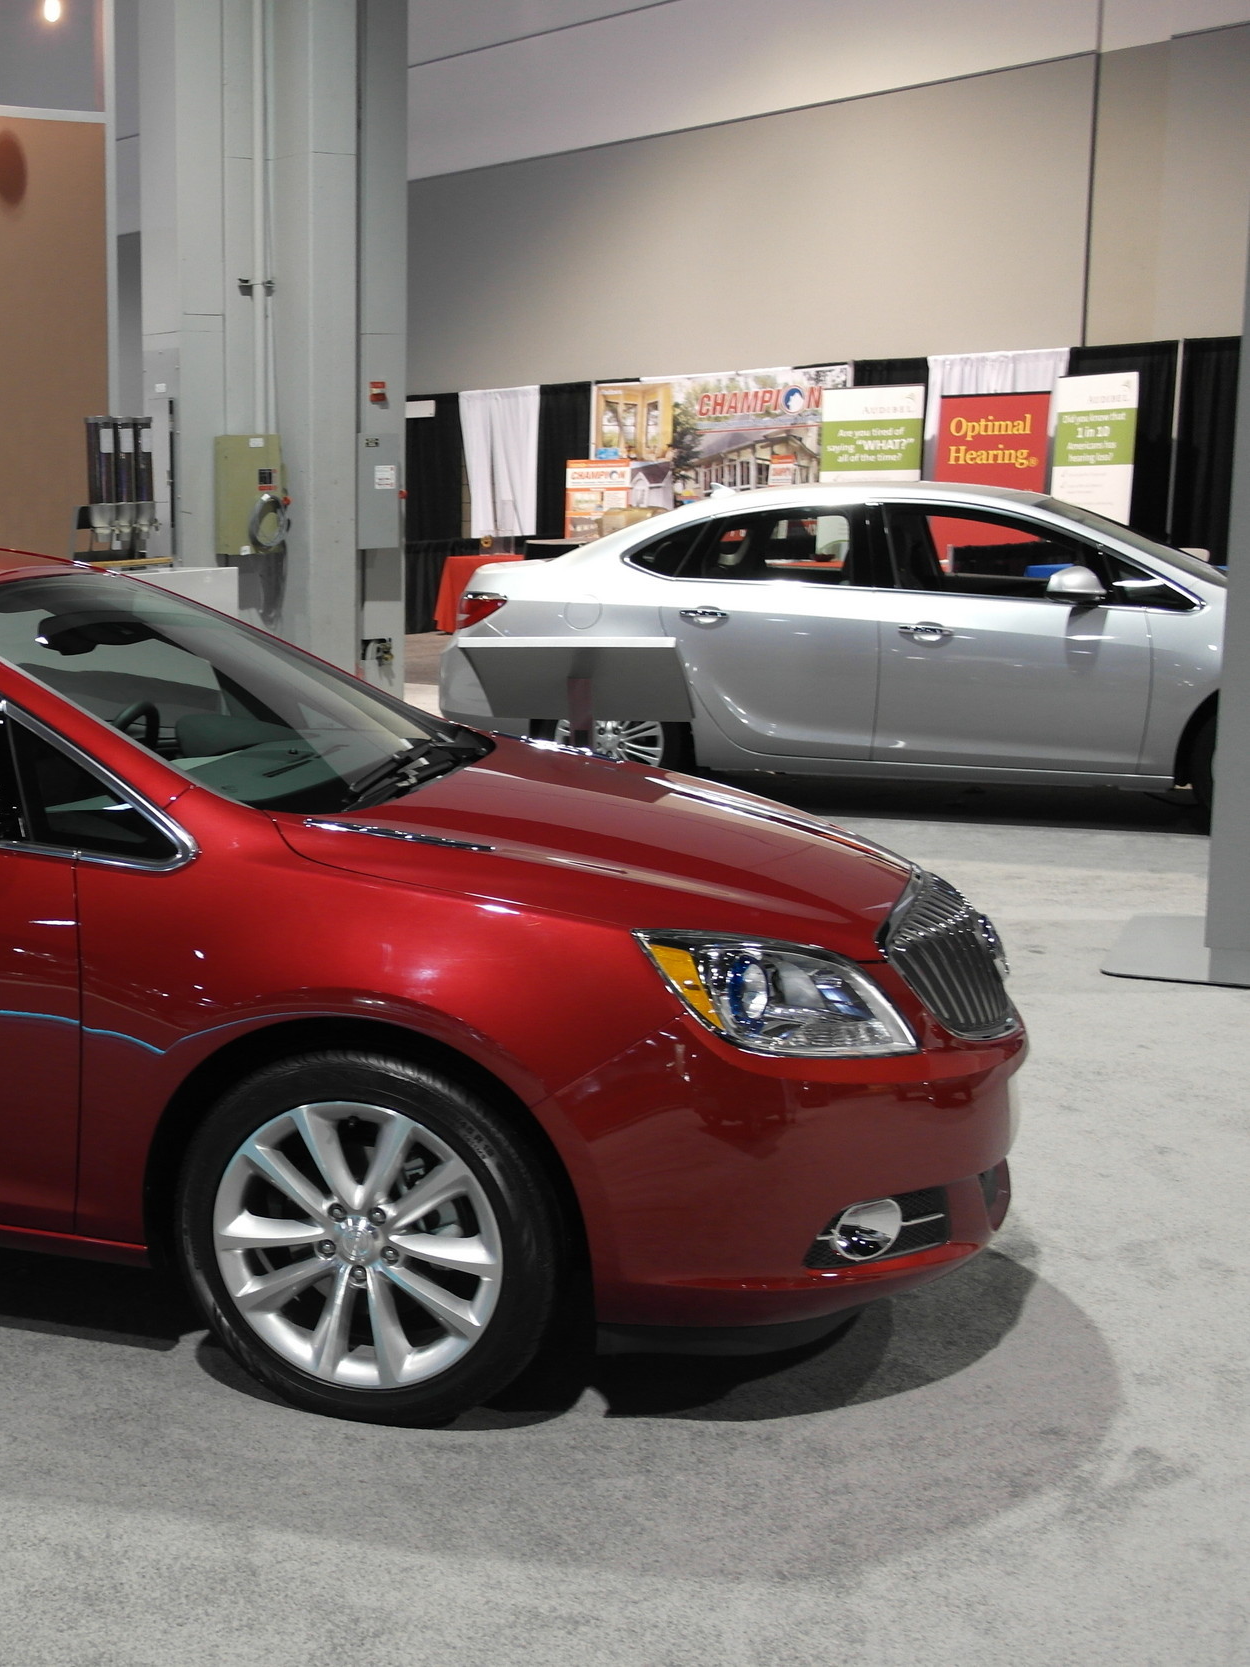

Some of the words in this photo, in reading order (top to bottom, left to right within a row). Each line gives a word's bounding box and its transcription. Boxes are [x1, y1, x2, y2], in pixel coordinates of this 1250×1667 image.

[837, 429, 853, 437] Are
[853, 430, 870, 439] you
[872, 428, 893, 436] tired
[894, 427, 905, 435] of
[950, 413, 1032, 441] Optimal
[1076, 427, 1084, 438] 1
[1084, 426, 1095, 437] in
[1096, 426, 1111, 437] 10
[826, 443, 855, 453] saying
[837, 453, 849, 462] all
[850, 453, 860, 462] of
[860, 453, 876, 462] the
[877, 453, 903, 462] time?
